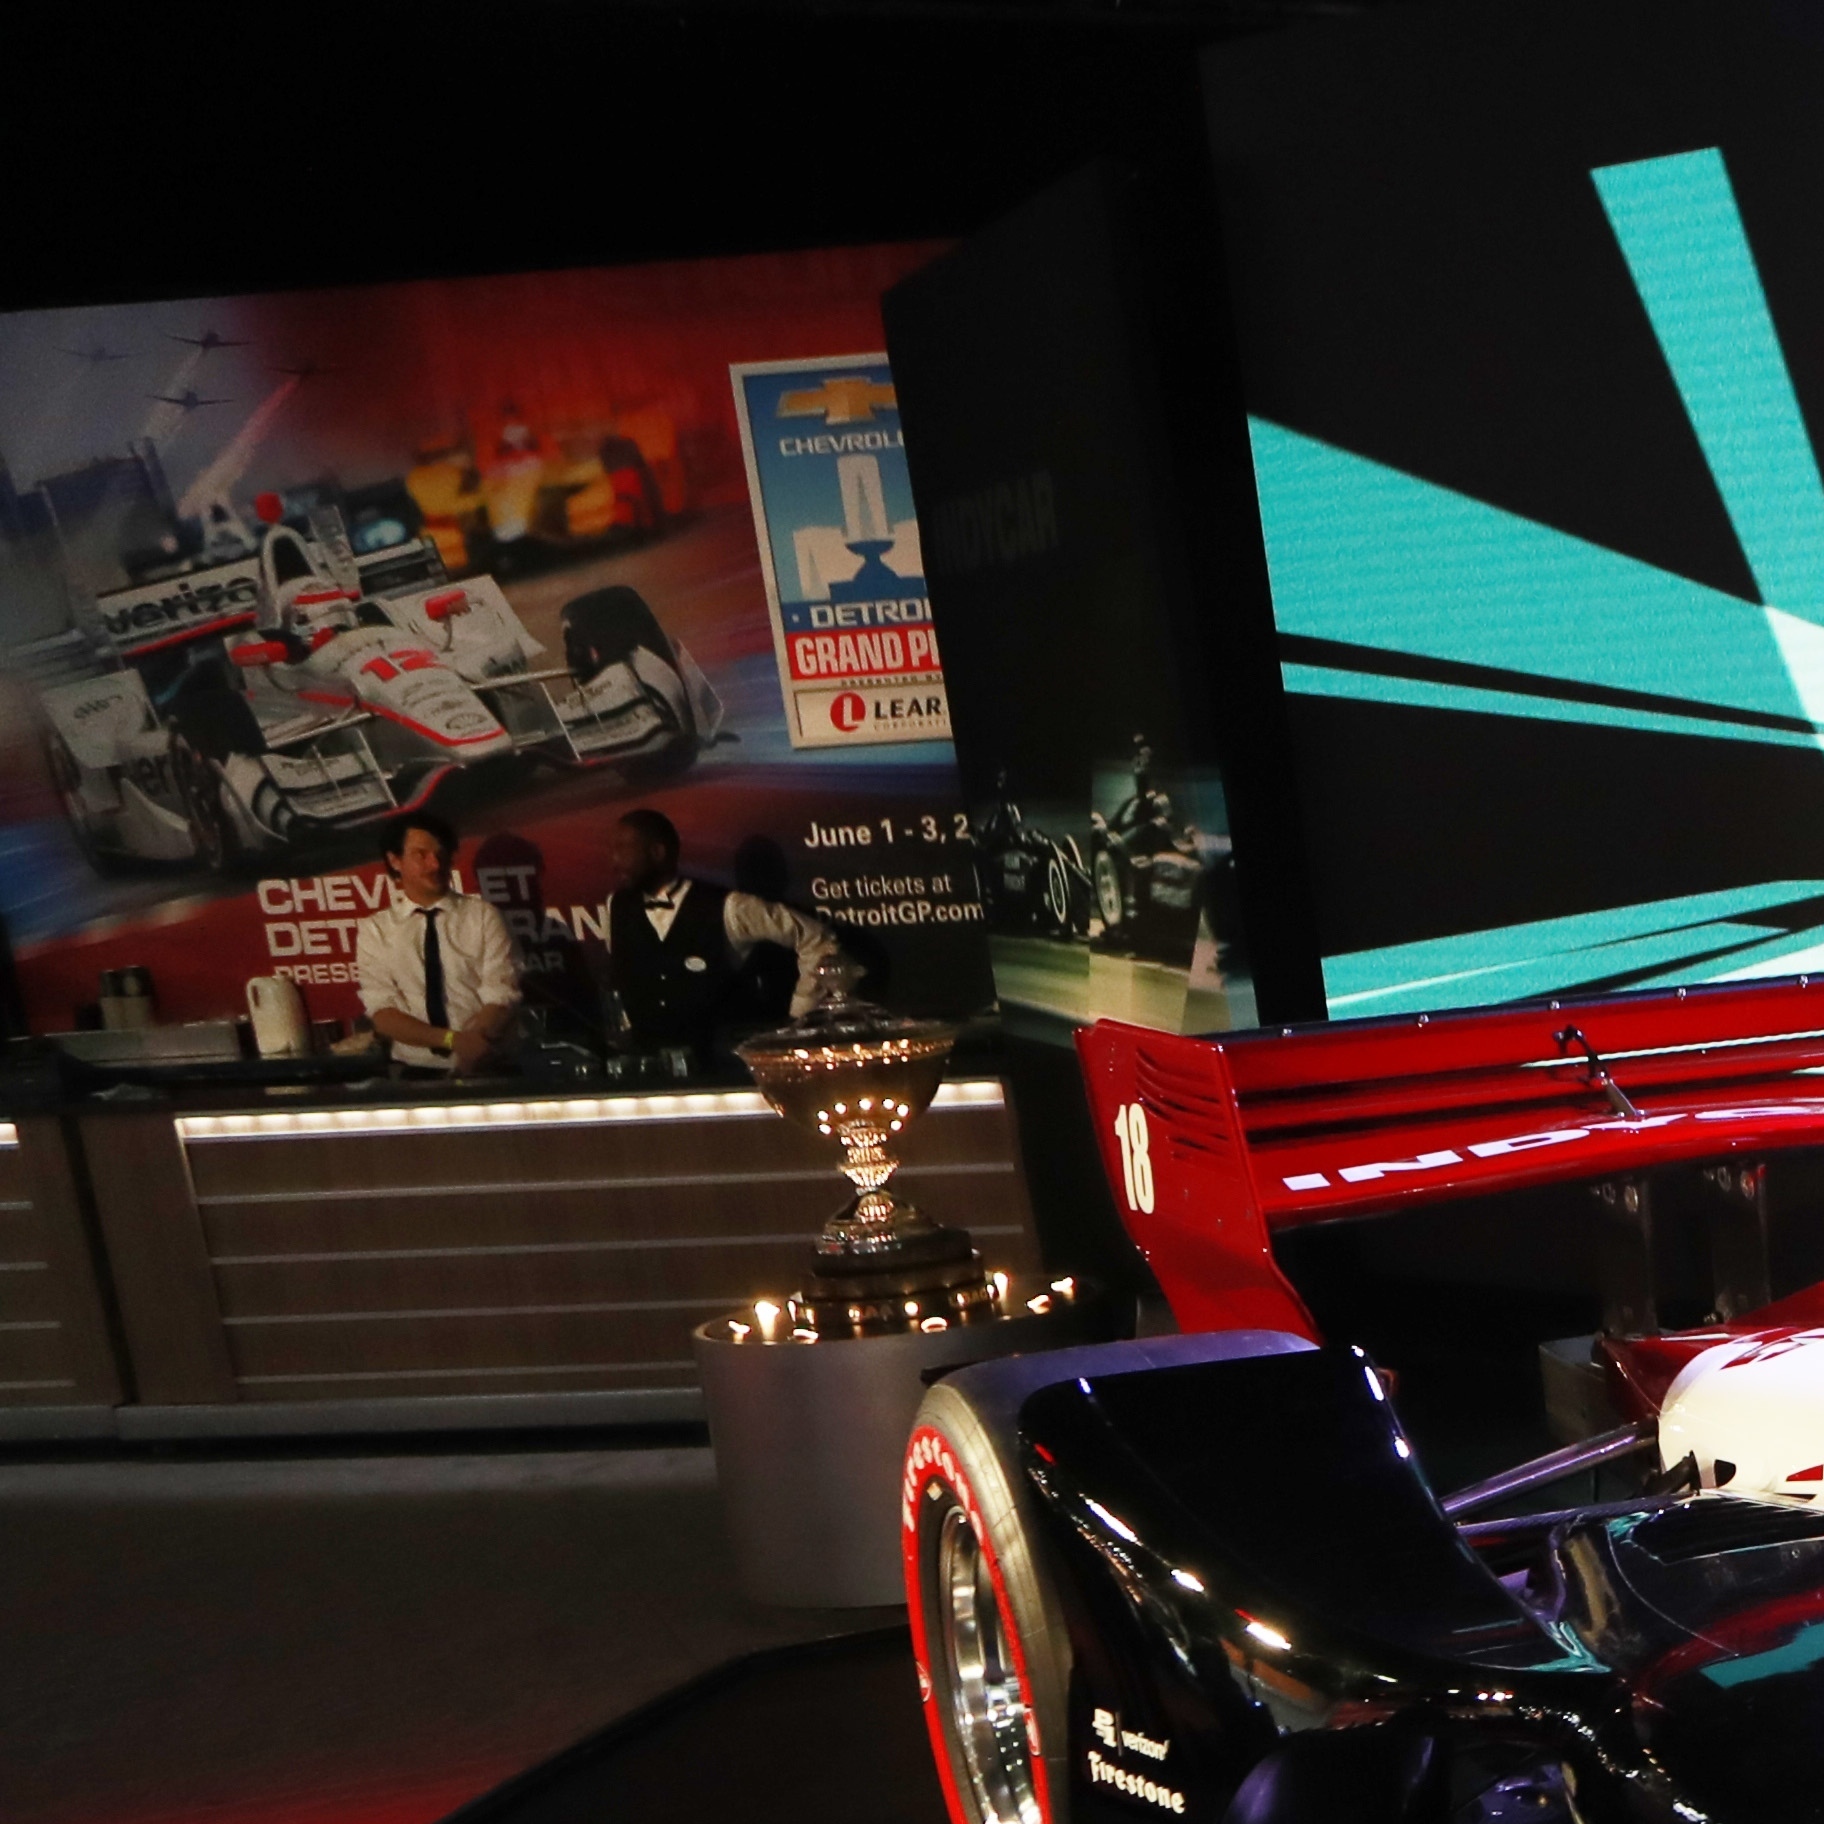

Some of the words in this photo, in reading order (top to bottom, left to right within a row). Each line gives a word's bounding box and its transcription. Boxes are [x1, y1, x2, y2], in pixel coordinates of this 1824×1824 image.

[779, 429, 905, 457] CHEVROL
[104, 577, 257, 635] verizo
[809, 598, 933, 629] DETROI
[795, 631, 905, 676] GRAND
[874, 697, 942, 721] LEAR
[804, 822, 872, 848] June
[880, 818, 894, 844] 1
[921, 815, 947, 845] 3,
[257, 865, 536, 915] CHEVLET
[811, 877, 851, 900] Get
[855, 875, 926, 899] tickets
[932, 873, 952, 894] at
[1114, 1102, 1157, 1214] 18
[1087, 1750, 1186, 1814] Firestone
